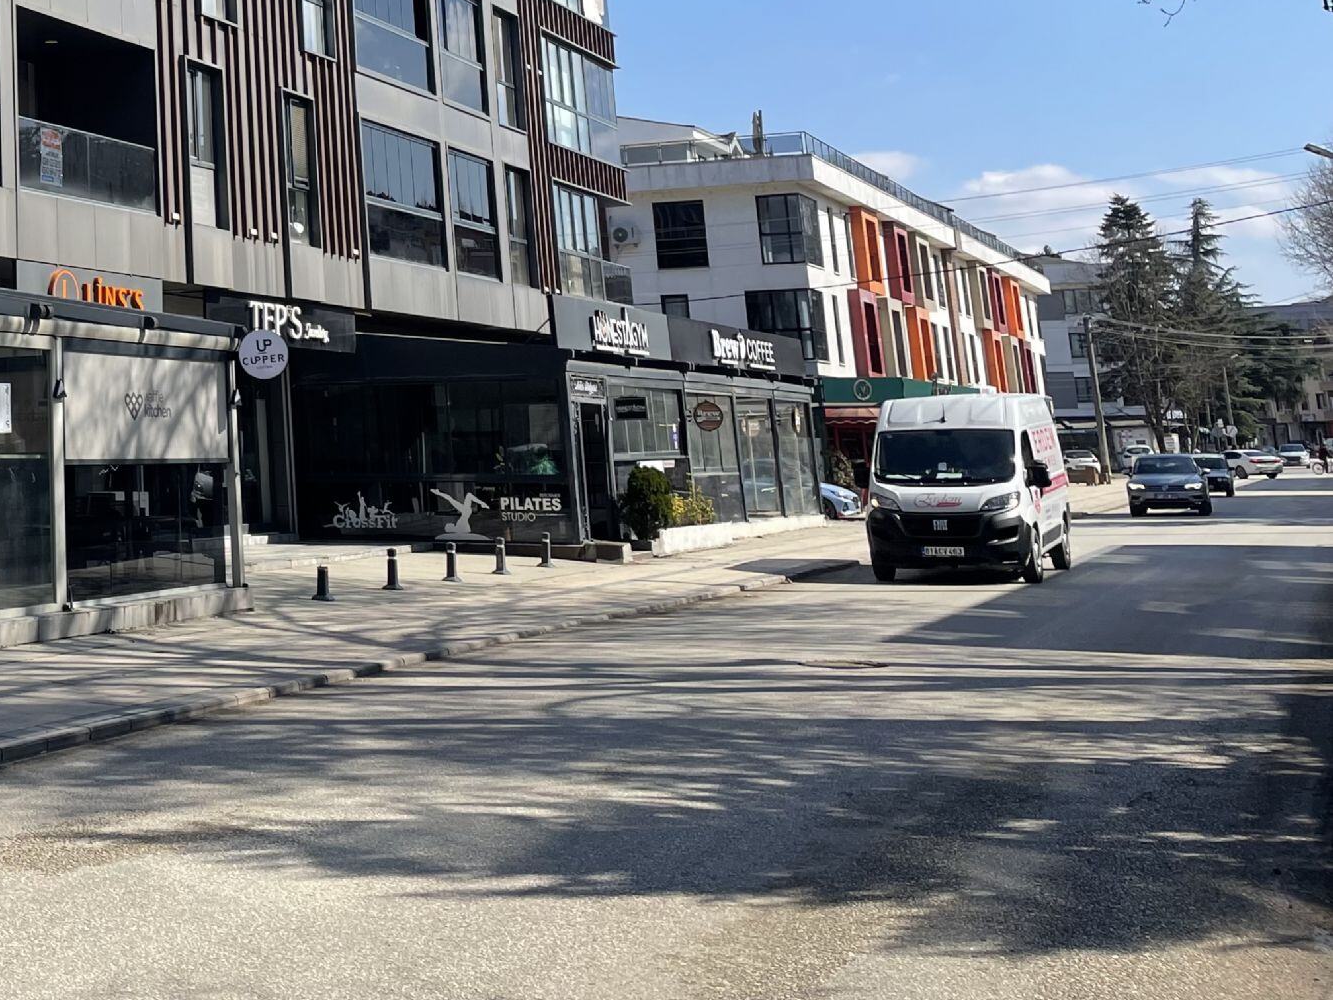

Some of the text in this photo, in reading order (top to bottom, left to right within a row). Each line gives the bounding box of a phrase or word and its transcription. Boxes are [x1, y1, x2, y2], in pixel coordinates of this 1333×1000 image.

[256, 338, 272, 352] UP
[711, 328, 776, 363] Brew COFFEE
[242, 353, 285, 366] CUPPER
[500, 496, 562, 511] PILATES
[332, 514, 398, 529] CrossFit
[501, 511, 536, 522] STUDIO
